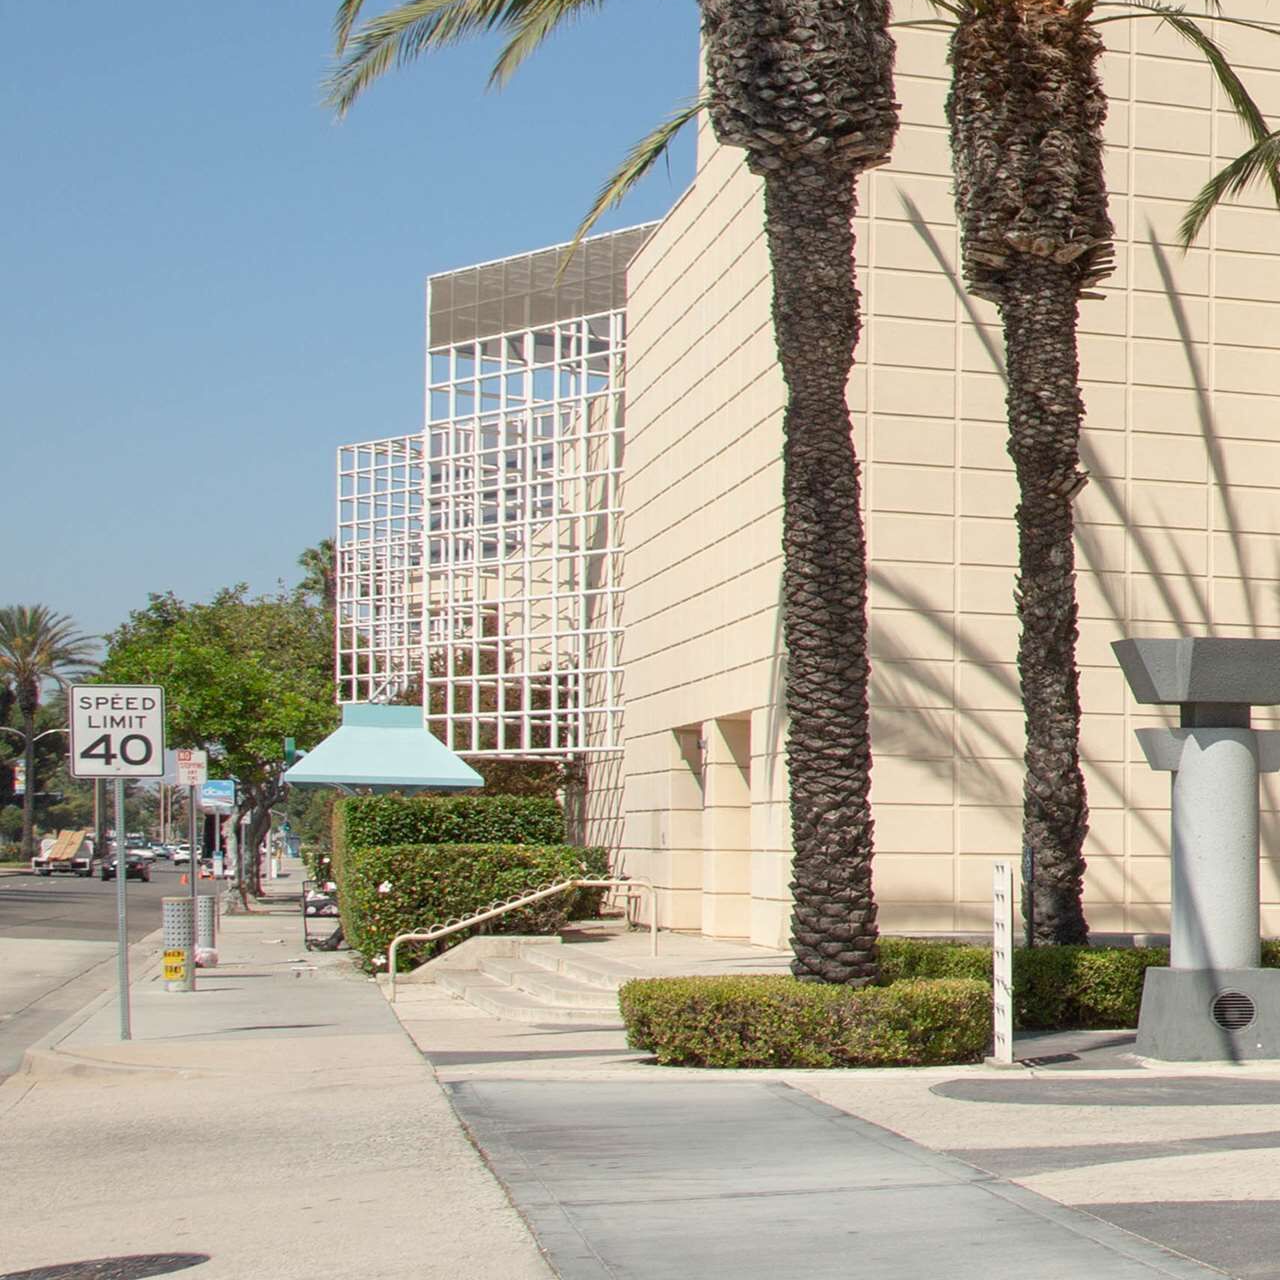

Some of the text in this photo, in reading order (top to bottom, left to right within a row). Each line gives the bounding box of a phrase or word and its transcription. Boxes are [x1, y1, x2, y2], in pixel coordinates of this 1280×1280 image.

[79, 696, 156, 711] SPEED
[88, 715, 147, 729] LIMIT
[80, 733, 153, 766] 40
